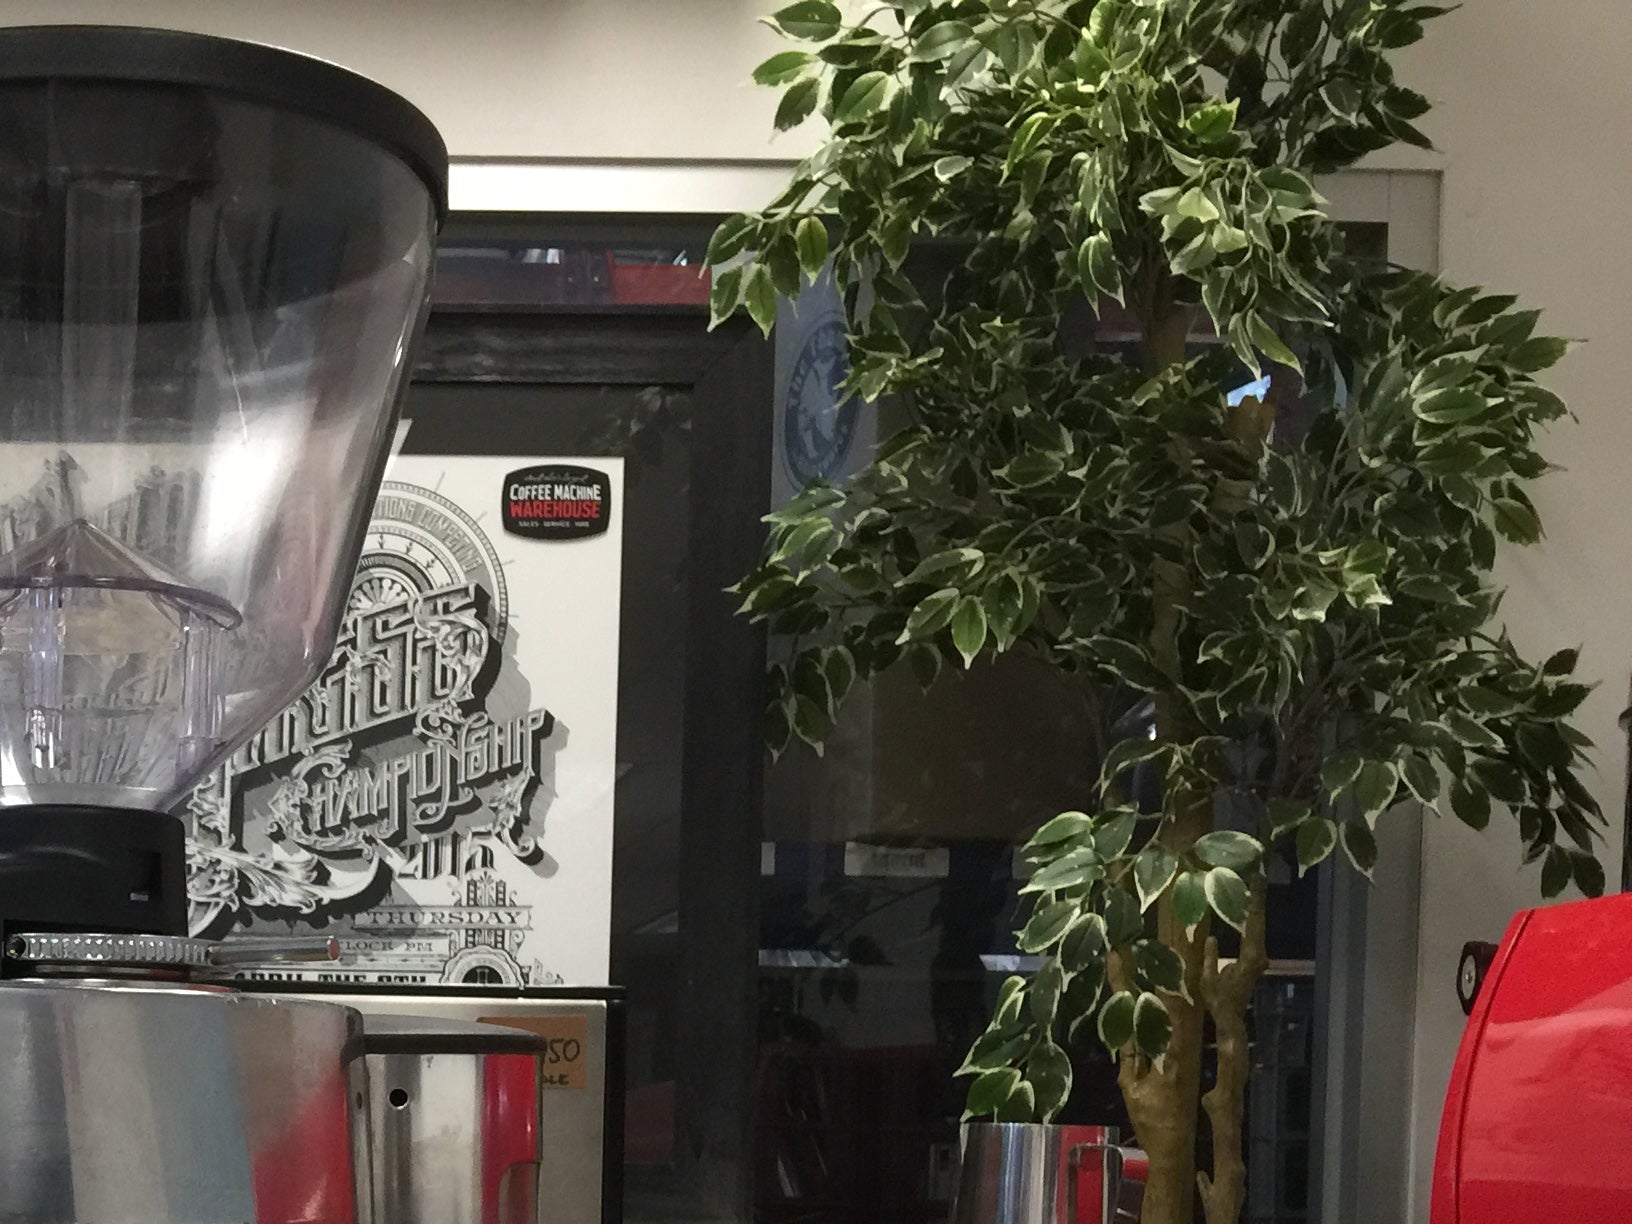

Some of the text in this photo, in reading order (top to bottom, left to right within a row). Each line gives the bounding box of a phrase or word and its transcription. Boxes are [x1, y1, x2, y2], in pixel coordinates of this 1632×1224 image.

[509, 484, 601, 501] COFFEE MACHINE
[510, 500, 601, 518] WAREHOUSE
[268, 706, 548, 846] CHAMPIONSHIP
[370, 911, 521, 926] THURSDAY
